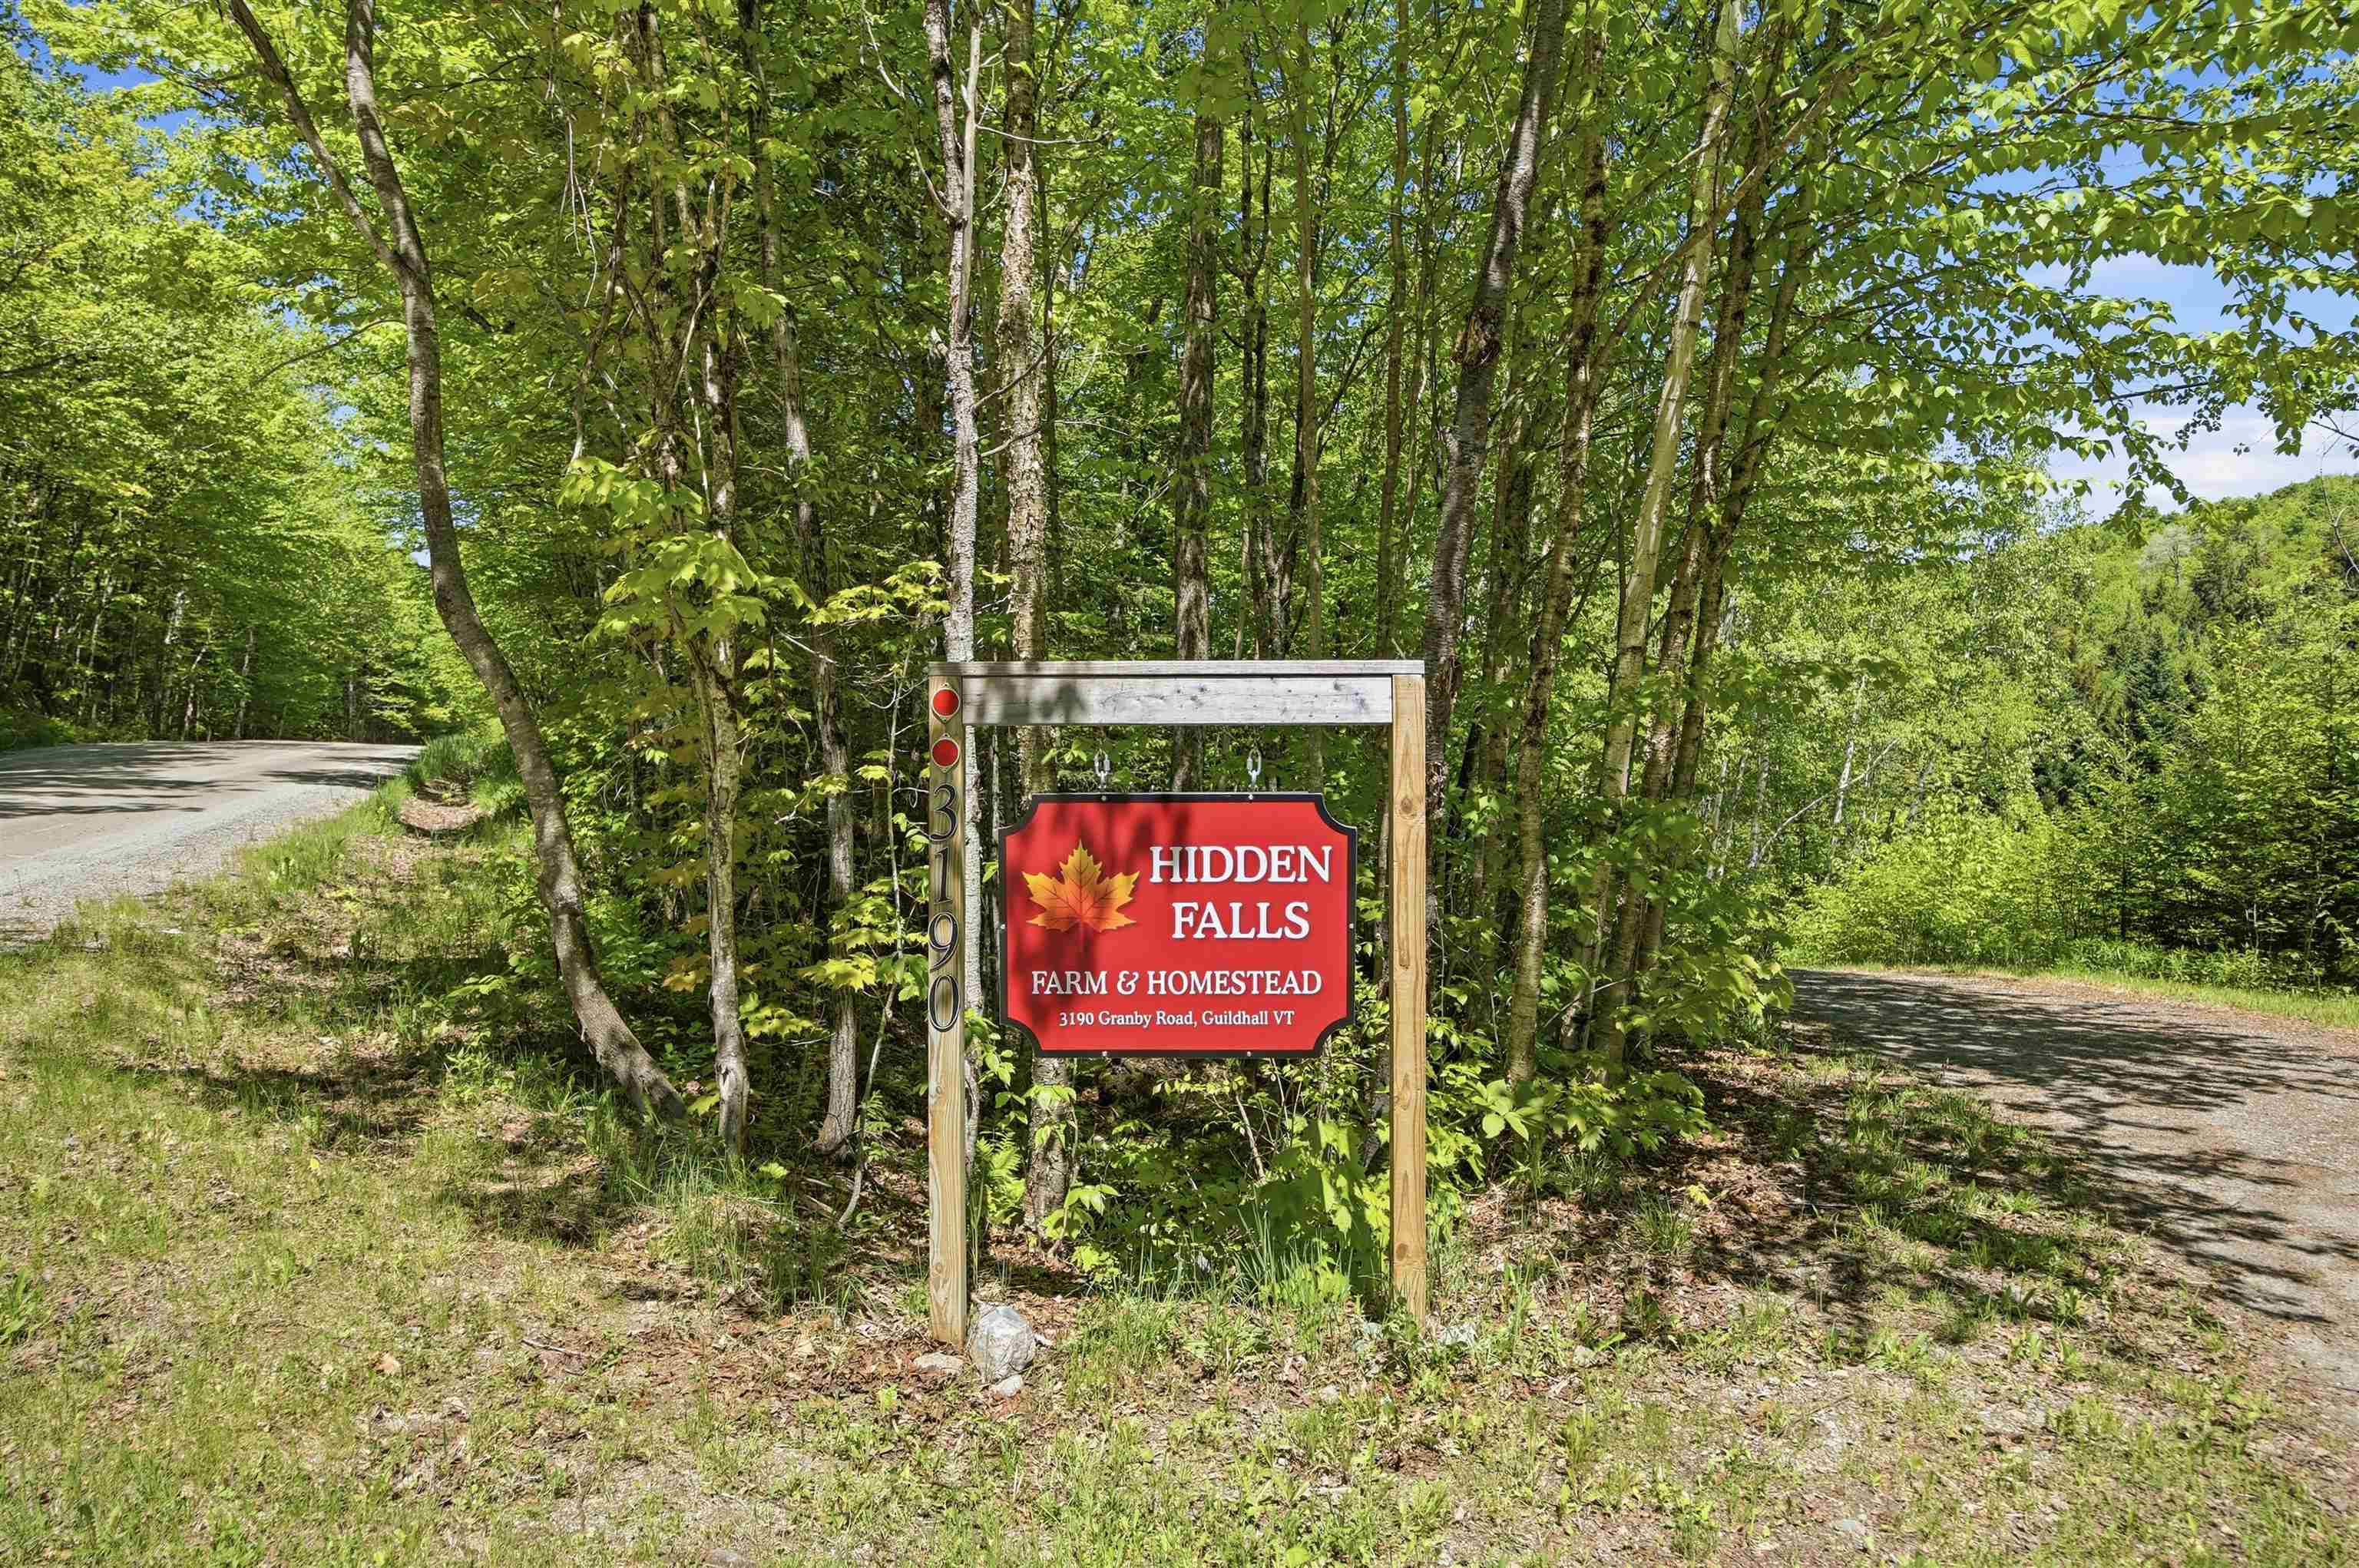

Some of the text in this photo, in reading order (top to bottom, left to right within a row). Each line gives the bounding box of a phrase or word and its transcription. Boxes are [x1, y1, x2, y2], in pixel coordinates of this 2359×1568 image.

[1150, 846, 1332, 883] HIDDEN
[928, 783, 960, 1032] 3190
[1171, 901, 1310, 939] FALLS
[1031, 971, 1322, 995] FARM & HOMESTEAD
[1059, 1011, 1295, 1028] 3190 Granby Road, Guildhall VT
